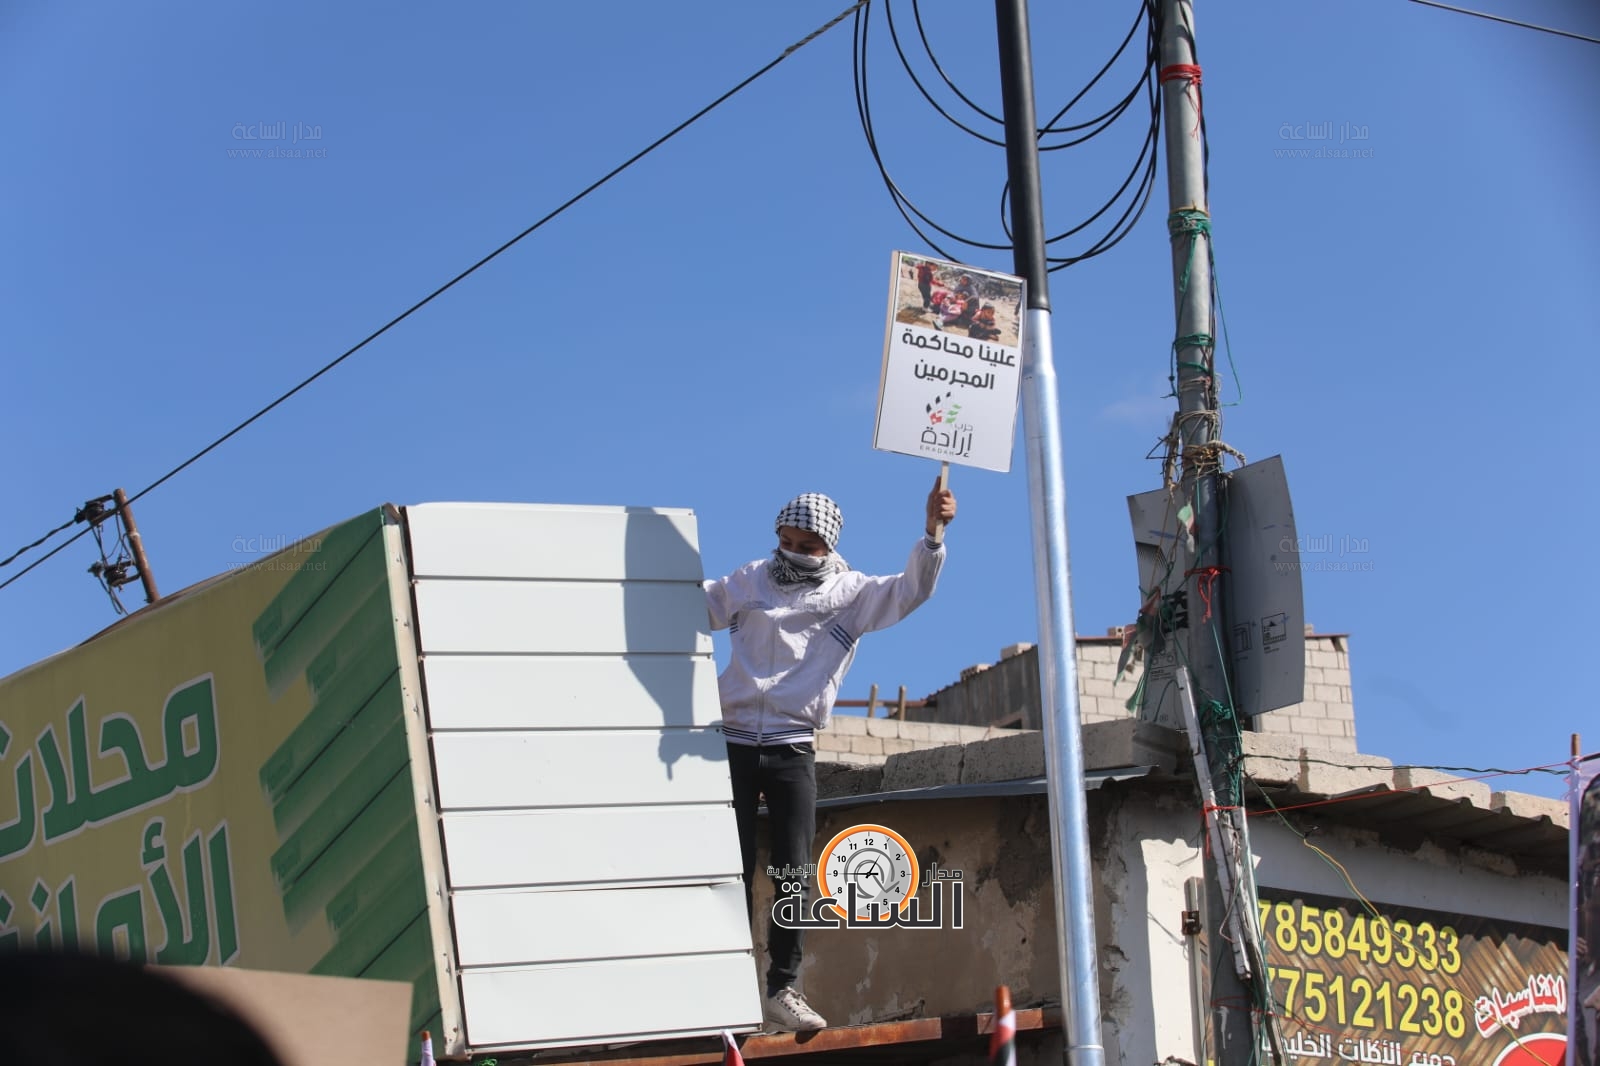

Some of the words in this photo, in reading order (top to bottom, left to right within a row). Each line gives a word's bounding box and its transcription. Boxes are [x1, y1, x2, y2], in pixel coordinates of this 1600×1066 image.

[902, 328, 973, 359] محاكمة
[979, 344, 1016, 367] علينا
[914, 359, 995, 390] المجرمين
[921, 426, 973, 457] إرادة
